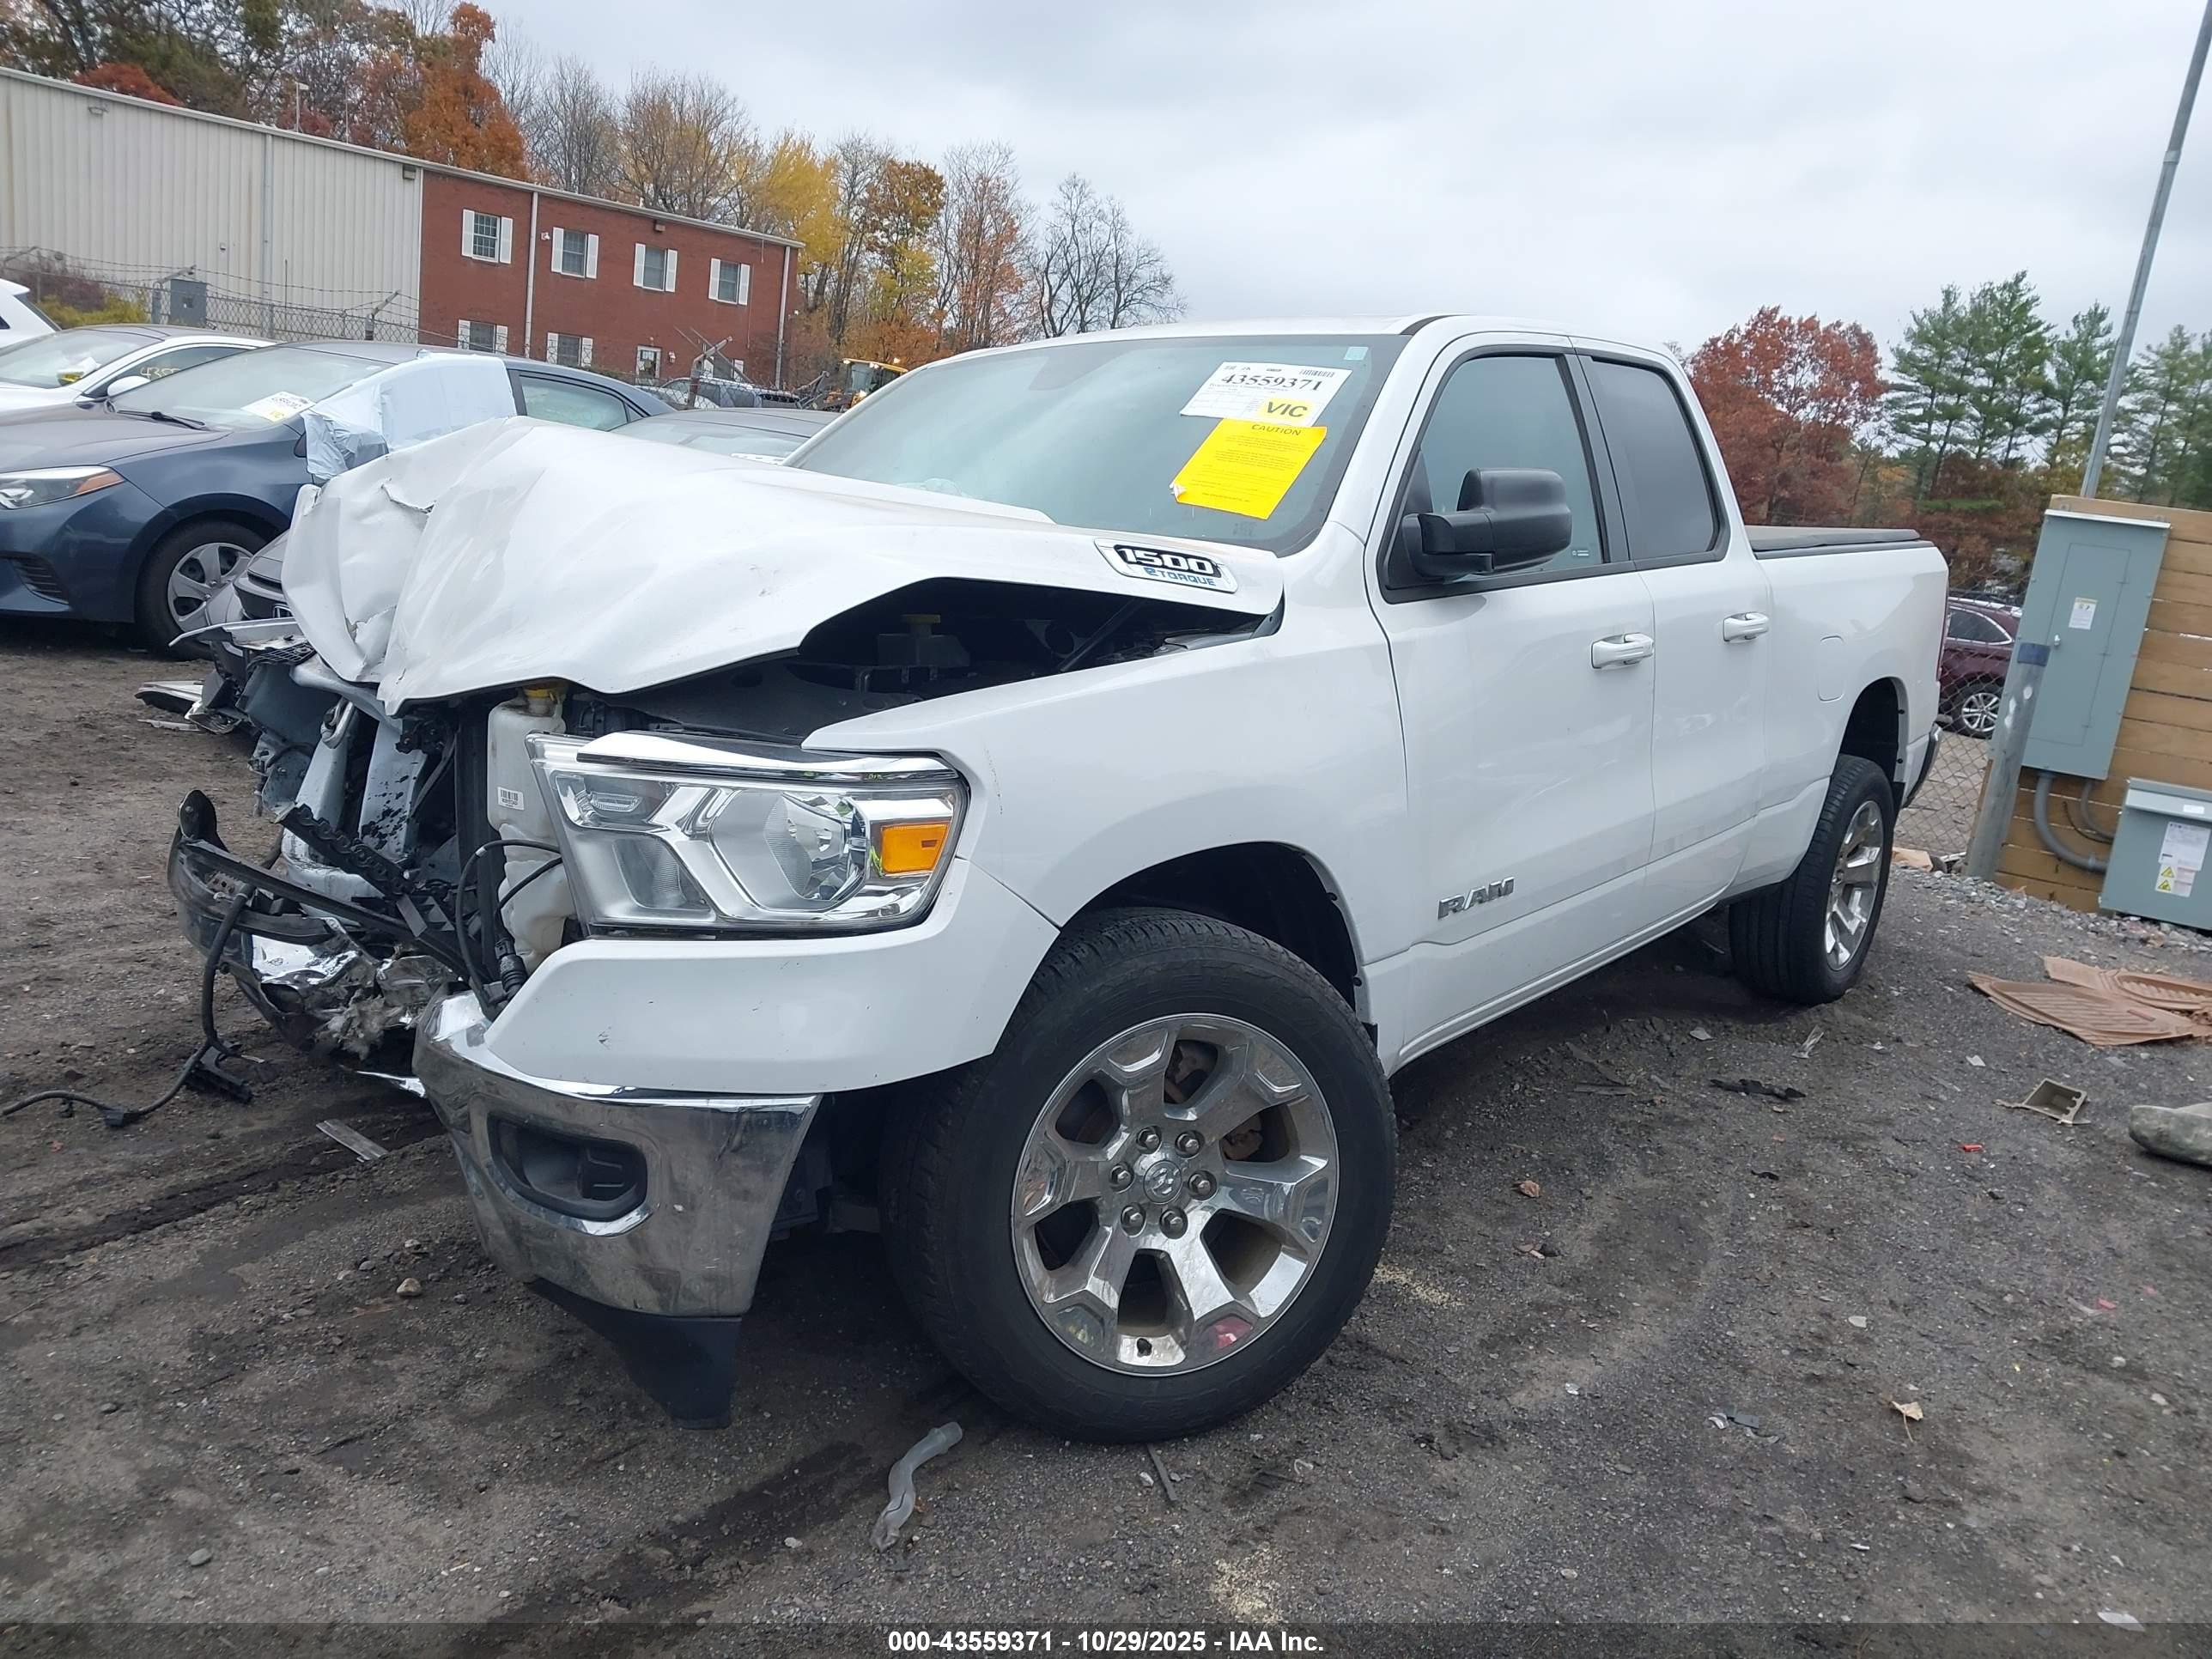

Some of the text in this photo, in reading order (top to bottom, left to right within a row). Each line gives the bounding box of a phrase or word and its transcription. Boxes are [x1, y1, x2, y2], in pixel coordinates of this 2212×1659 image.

[1221, 373, 1322, 392] 43559371
[1267, 401, 1308, 418] VIC
[1251, 423, 1302, 436] CAUTION
[1117, 546, 1215, 575] 1500
[1437, 876, 1515, 921] RAM
